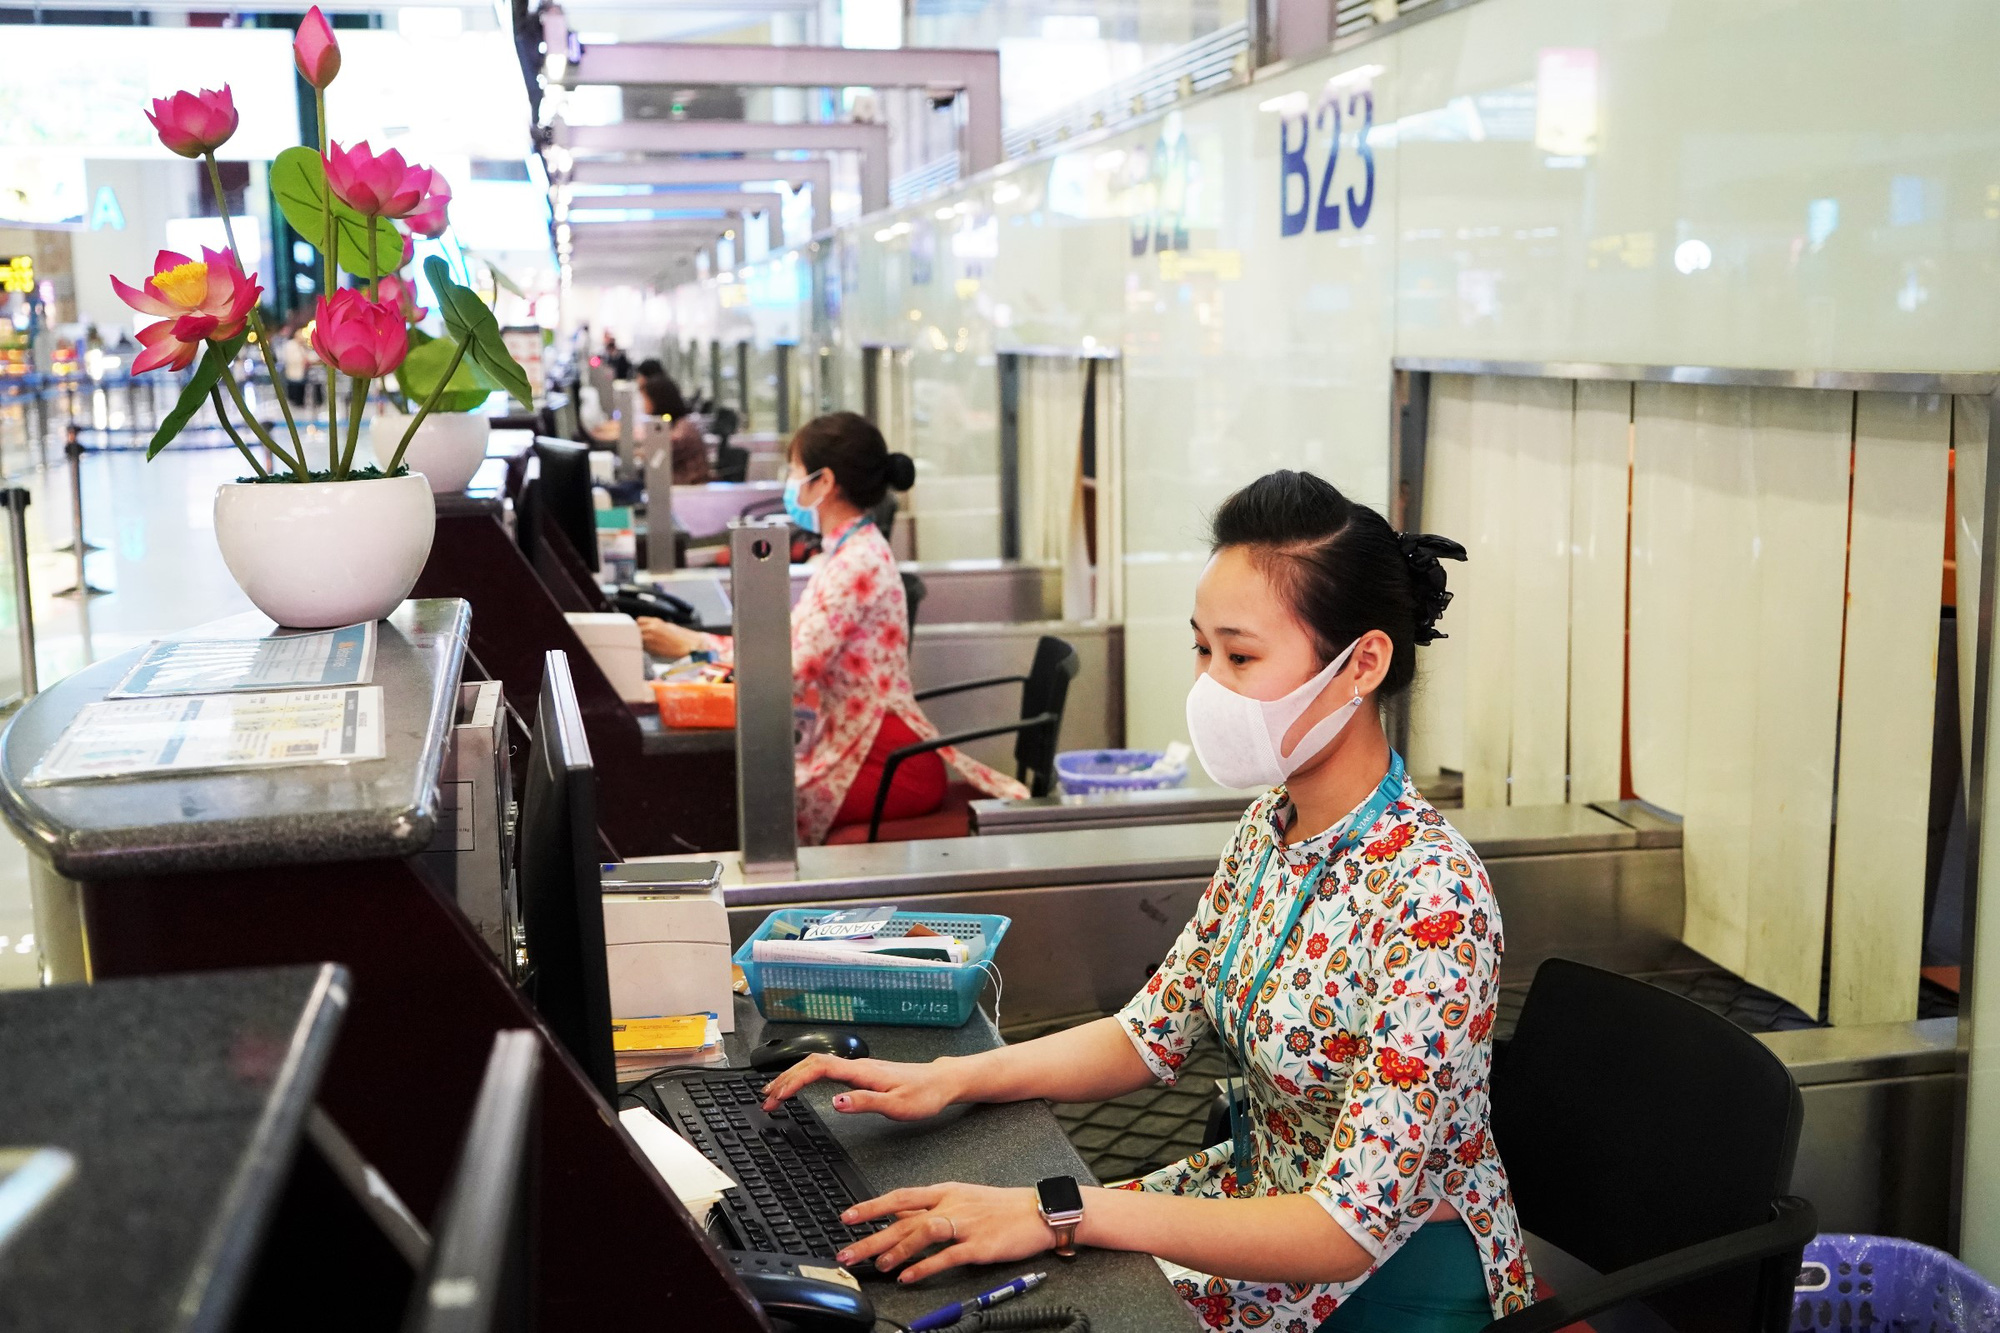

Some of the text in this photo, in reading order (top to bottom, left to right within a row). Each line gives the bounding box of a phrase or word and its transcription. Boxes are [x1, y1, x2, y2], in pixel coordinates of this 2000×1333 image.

[1281, 88, 1374, 237] B23
[91, 185, 126, 231] A
[1356, 808, 1376, 831] VIAGS
[1302, 866, 1319, 889] VIAGS
[809, 922, 879, 937] STANDBY
[1232, 920, 1245, 945] VIAGS
[901, 1001, 926, 1015] Dry
[929, 1001, 949, 1013] Ice
